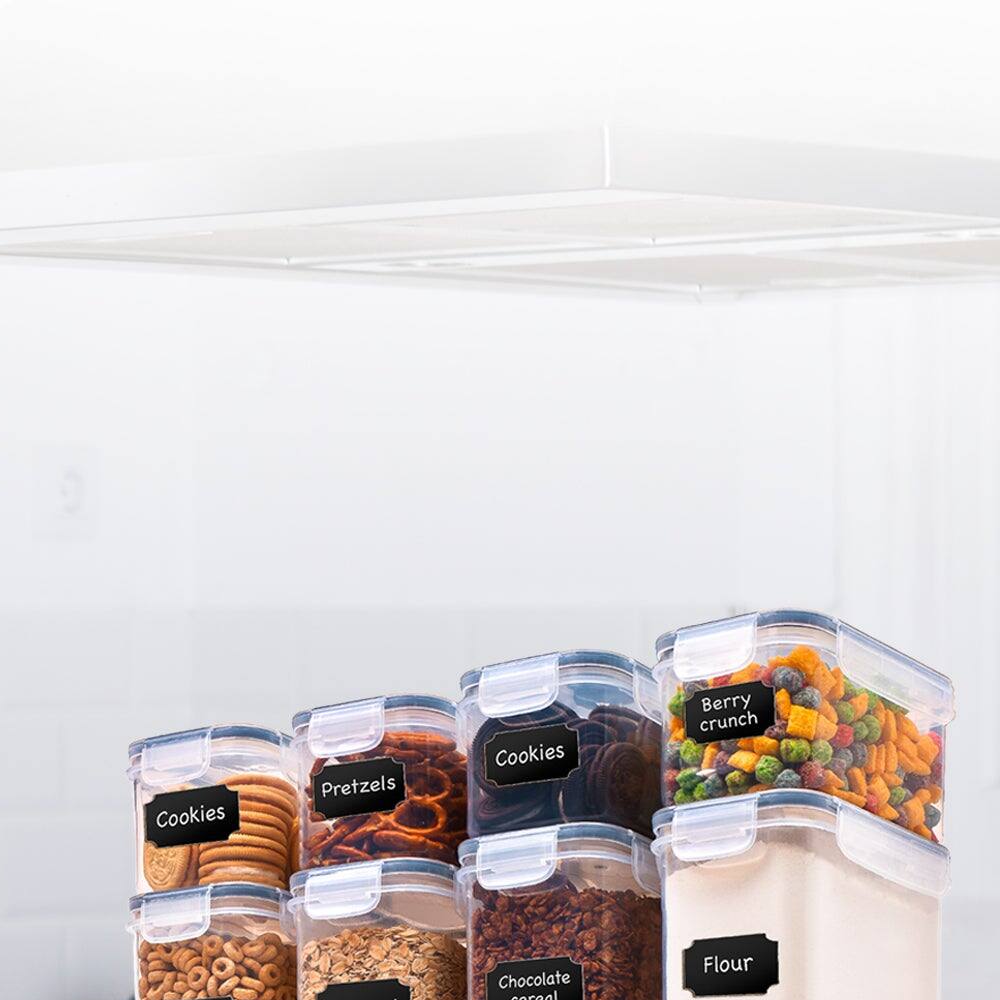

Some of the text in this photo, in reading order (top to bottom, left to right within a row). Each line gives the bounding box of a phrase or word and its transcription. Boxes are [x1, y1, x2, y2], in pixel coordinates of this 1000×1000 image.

[701, 694, 752, 712] Berry
[699, 711, 758, 731] crunch
[495, 743, 565, 767] Cookies
[321, 775, 396, 798] Pretzels
[156, 804, 226, 829] Cookies
[703, 955, 754, 974] Flour
[498, 970, 571, 990] Chocolate
